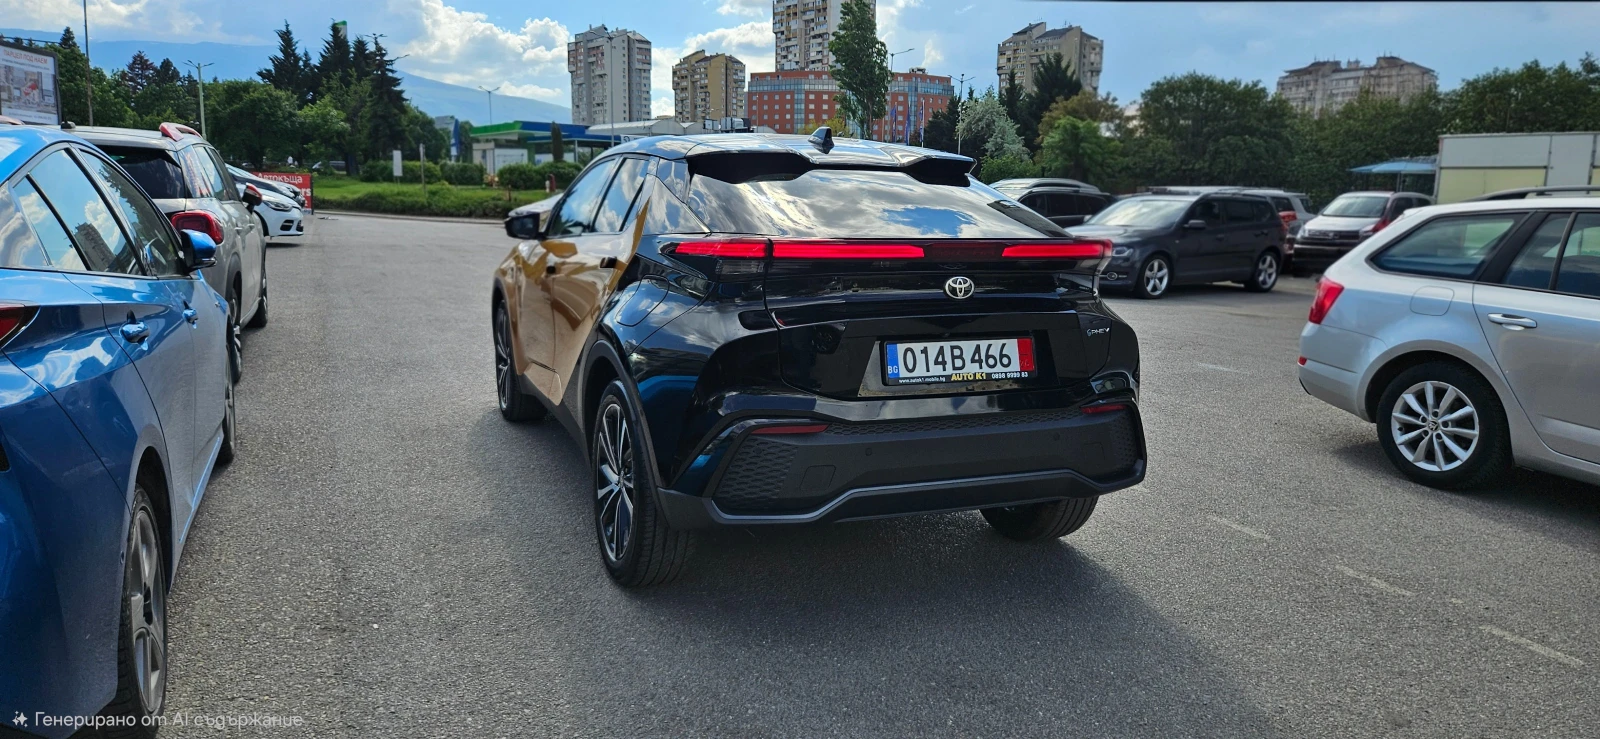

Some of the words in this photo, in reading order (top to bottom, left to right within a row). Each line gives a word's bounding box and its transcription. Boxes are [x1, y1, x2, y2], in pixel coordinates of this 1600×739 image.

[23, 54, 33, 63] ПОД
[257, 172, 303, 184] Автокъща
[887, 365, 898, 374] BG
[951, 372, 973, 381] AUTO
[976, 372, 986, 380] K1
